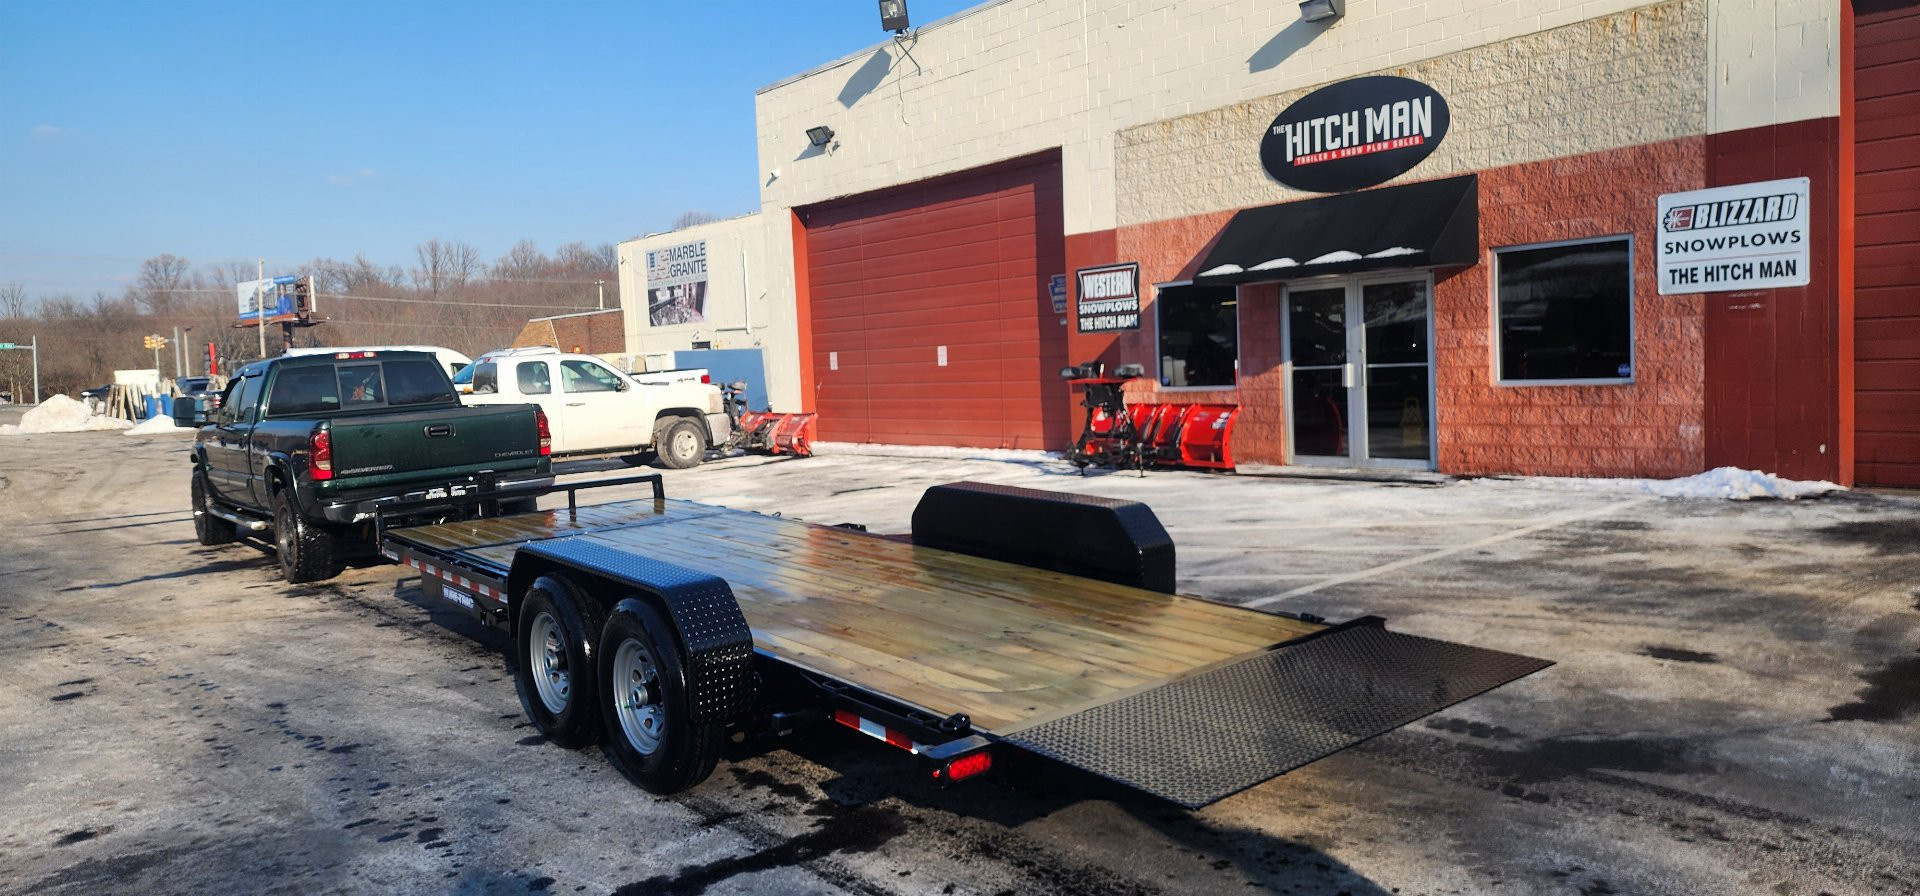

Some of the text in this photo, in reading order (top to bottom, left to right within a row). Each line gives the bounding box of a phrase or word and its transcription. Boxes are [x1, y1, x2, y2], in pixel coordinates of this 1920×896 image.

[1273, 96, 1432, 162] THE HITCH MAN
[1297, 136, 1420, 164] TRAILER & SNOW PLOW SALES
[1694, 193, 1799, 229] BLIZZARD
[669, 242, 706, 262] MARBLE
[1665, 230, 1801, 255] SNOWPLOWS
[670, 259, 707, 278] GRANITE
[1669, 260, 1797, 285] THE HITCH MAN
[1083, 270, 1132, 299] WESTERN
[1079, 300, 1138, 314] SNOWPLOWS
[1080, 314, 1138, 331] THE HITCH MAN
[494, 449, 534, 458] CHEVROLET
